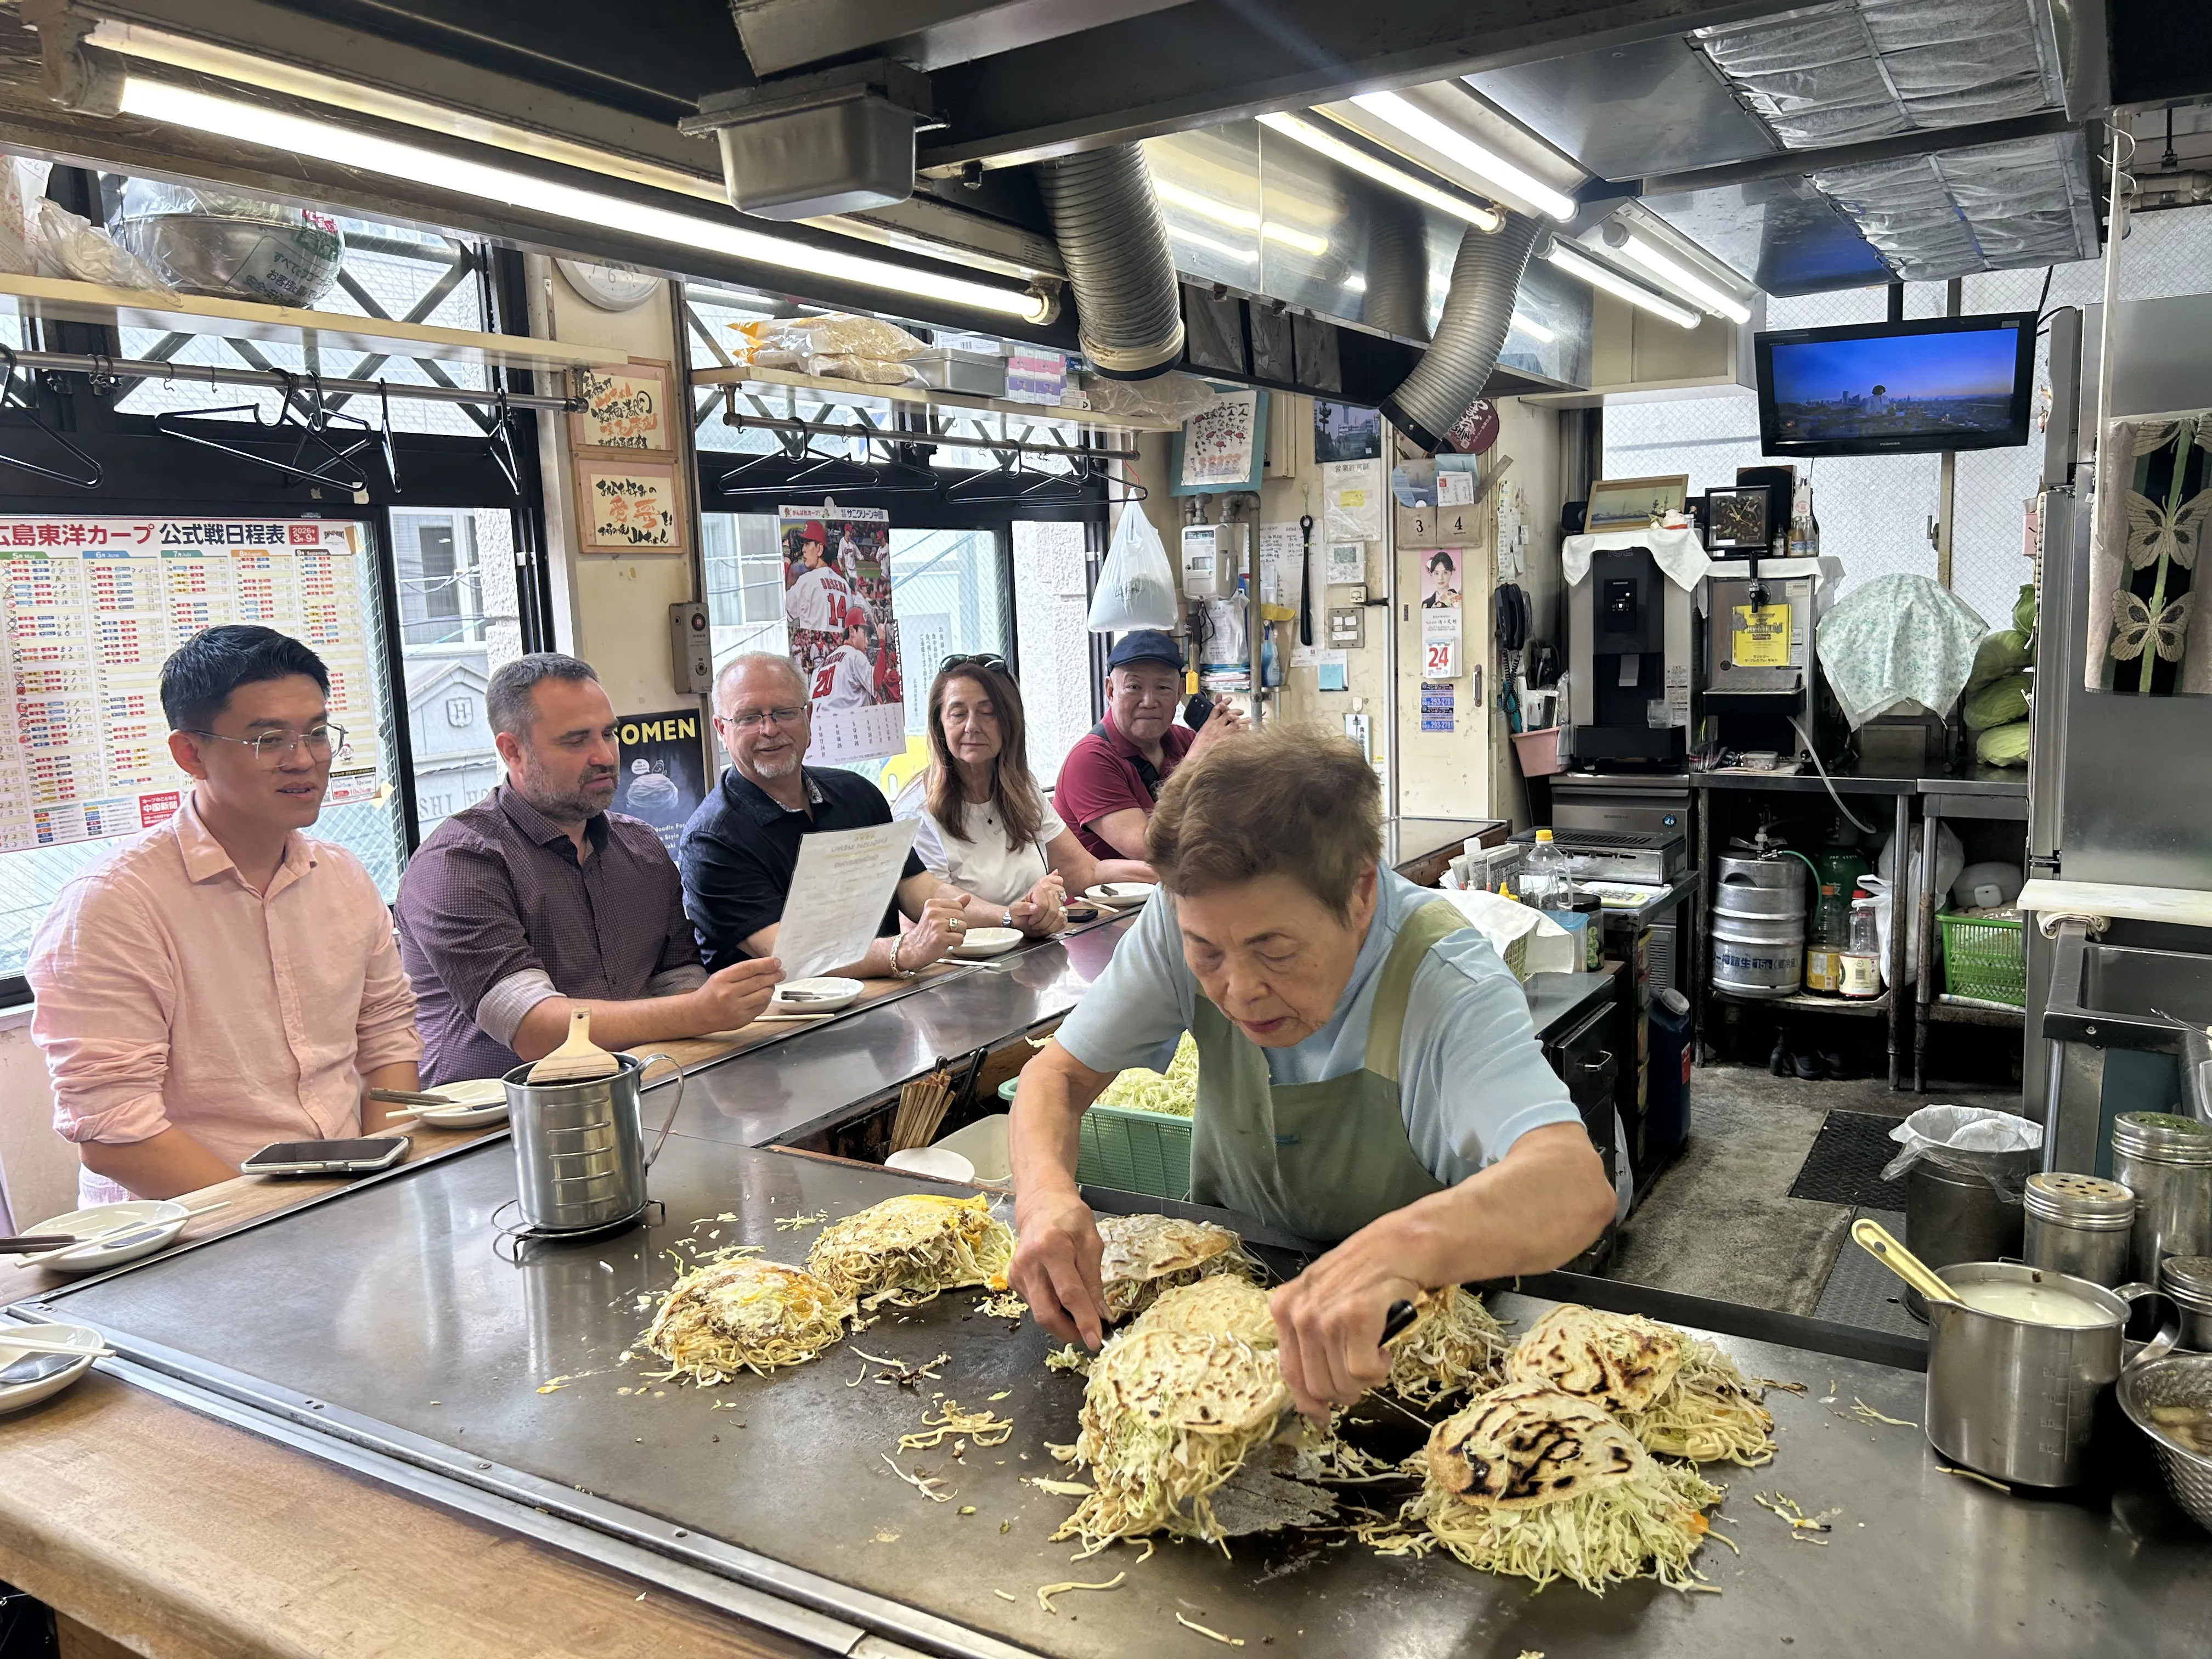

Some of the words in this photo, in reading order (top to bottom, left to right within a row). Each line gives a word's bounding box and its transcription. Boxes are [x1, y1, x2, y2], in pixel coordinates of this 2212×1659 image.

[608, 269, 616, 283] 6
[1335, 462, 1370, 472] 営業許可証
[847, 509, 884, 520] サニクリーン中国
[1415, 520, 1424, 533] 3
[1454, 516, 1463, 530] 4
[159, 523, 285, 545] 公式戦日程表
[827, 592, 847, 628] 14
[1741, 623, 1783, 634] REMIUM
[1429, 647, 1449, 667] 24
[812, 664, 836, 699] 20
[419, 793, 453, 818] SHI
